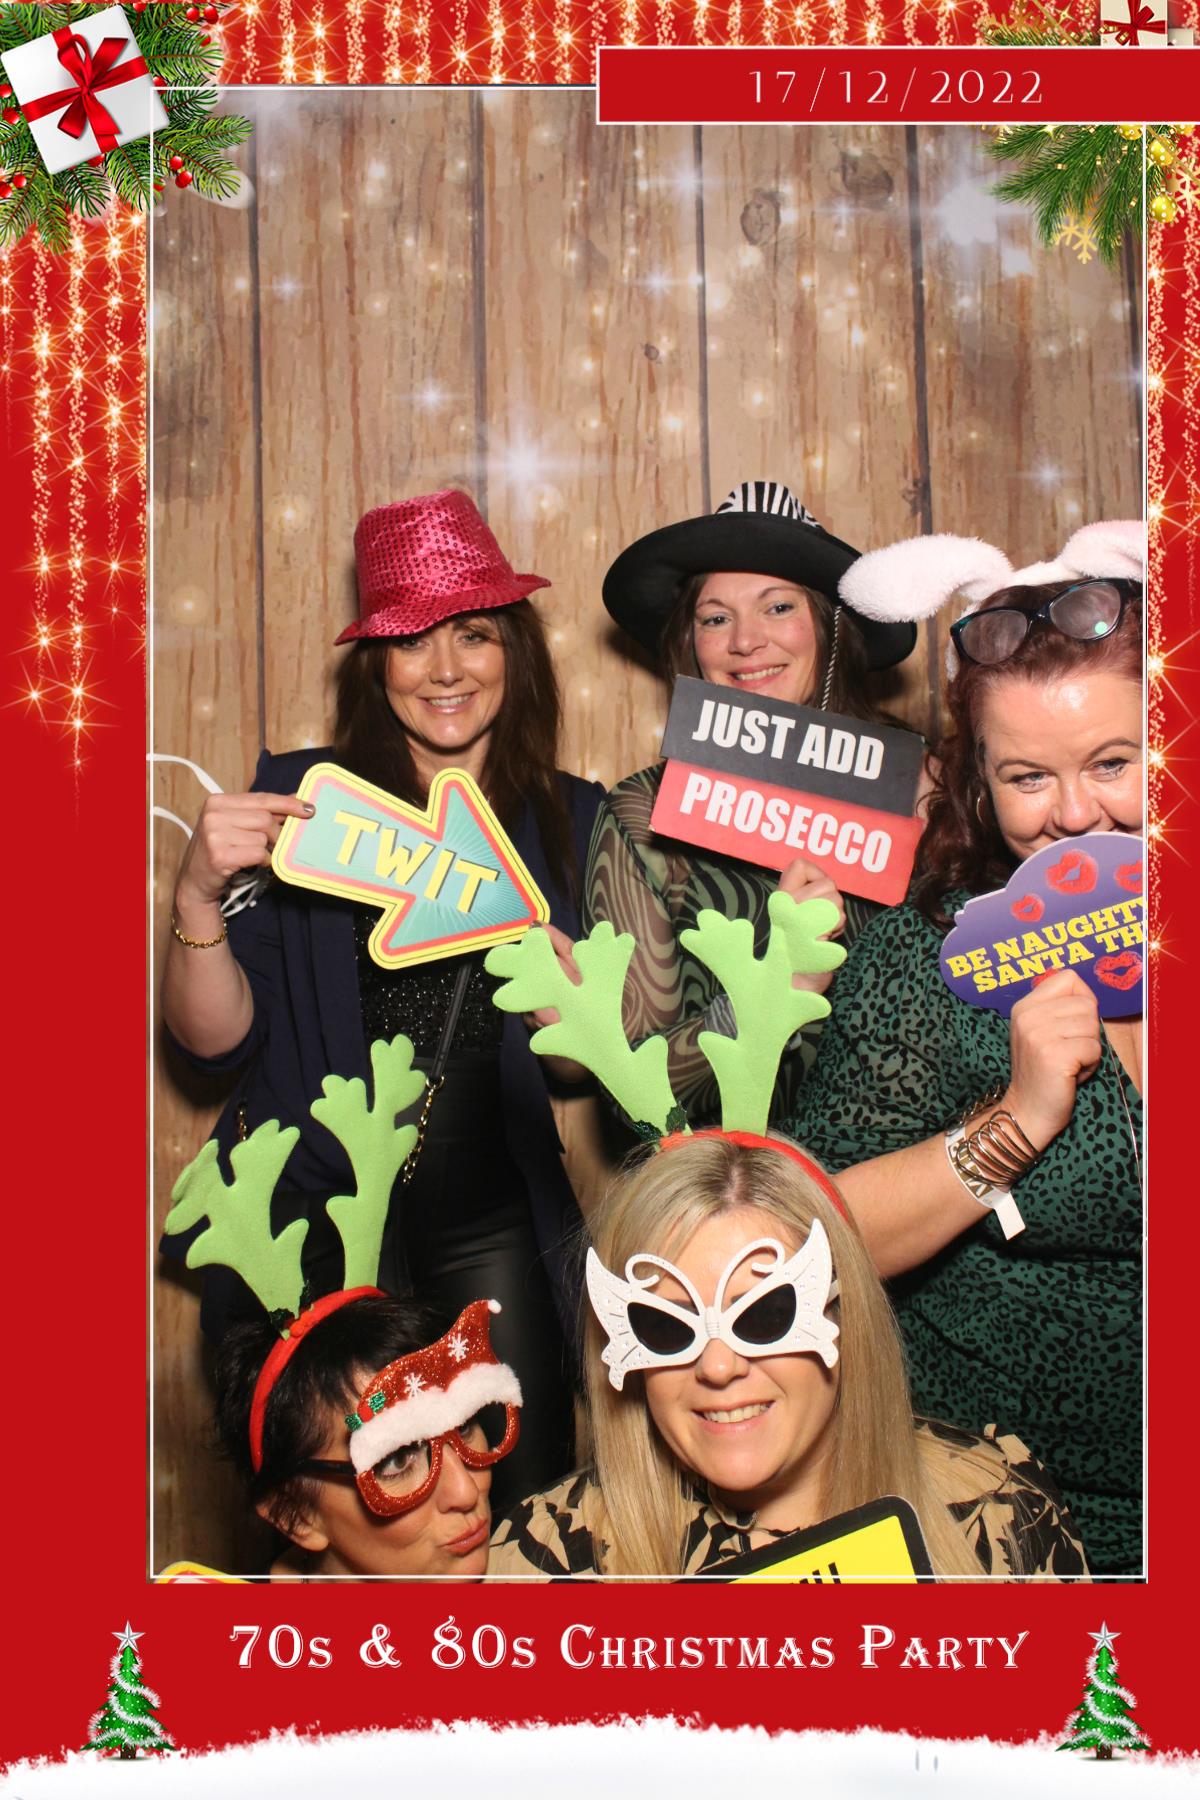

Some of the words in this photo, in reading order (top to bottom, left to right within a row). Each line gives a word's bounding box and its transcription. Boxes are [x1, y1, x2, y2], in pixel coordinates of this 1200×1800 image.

[692, 699, 796, 760] JUST
[797, 723, 885, 780] ADD
[333, 810, 500, 914] TWIT
[679, 772, 892, 873] PROSECCO
[945, 947, 992, 978] BE
[972, 941, 1095, 993] SANTA
